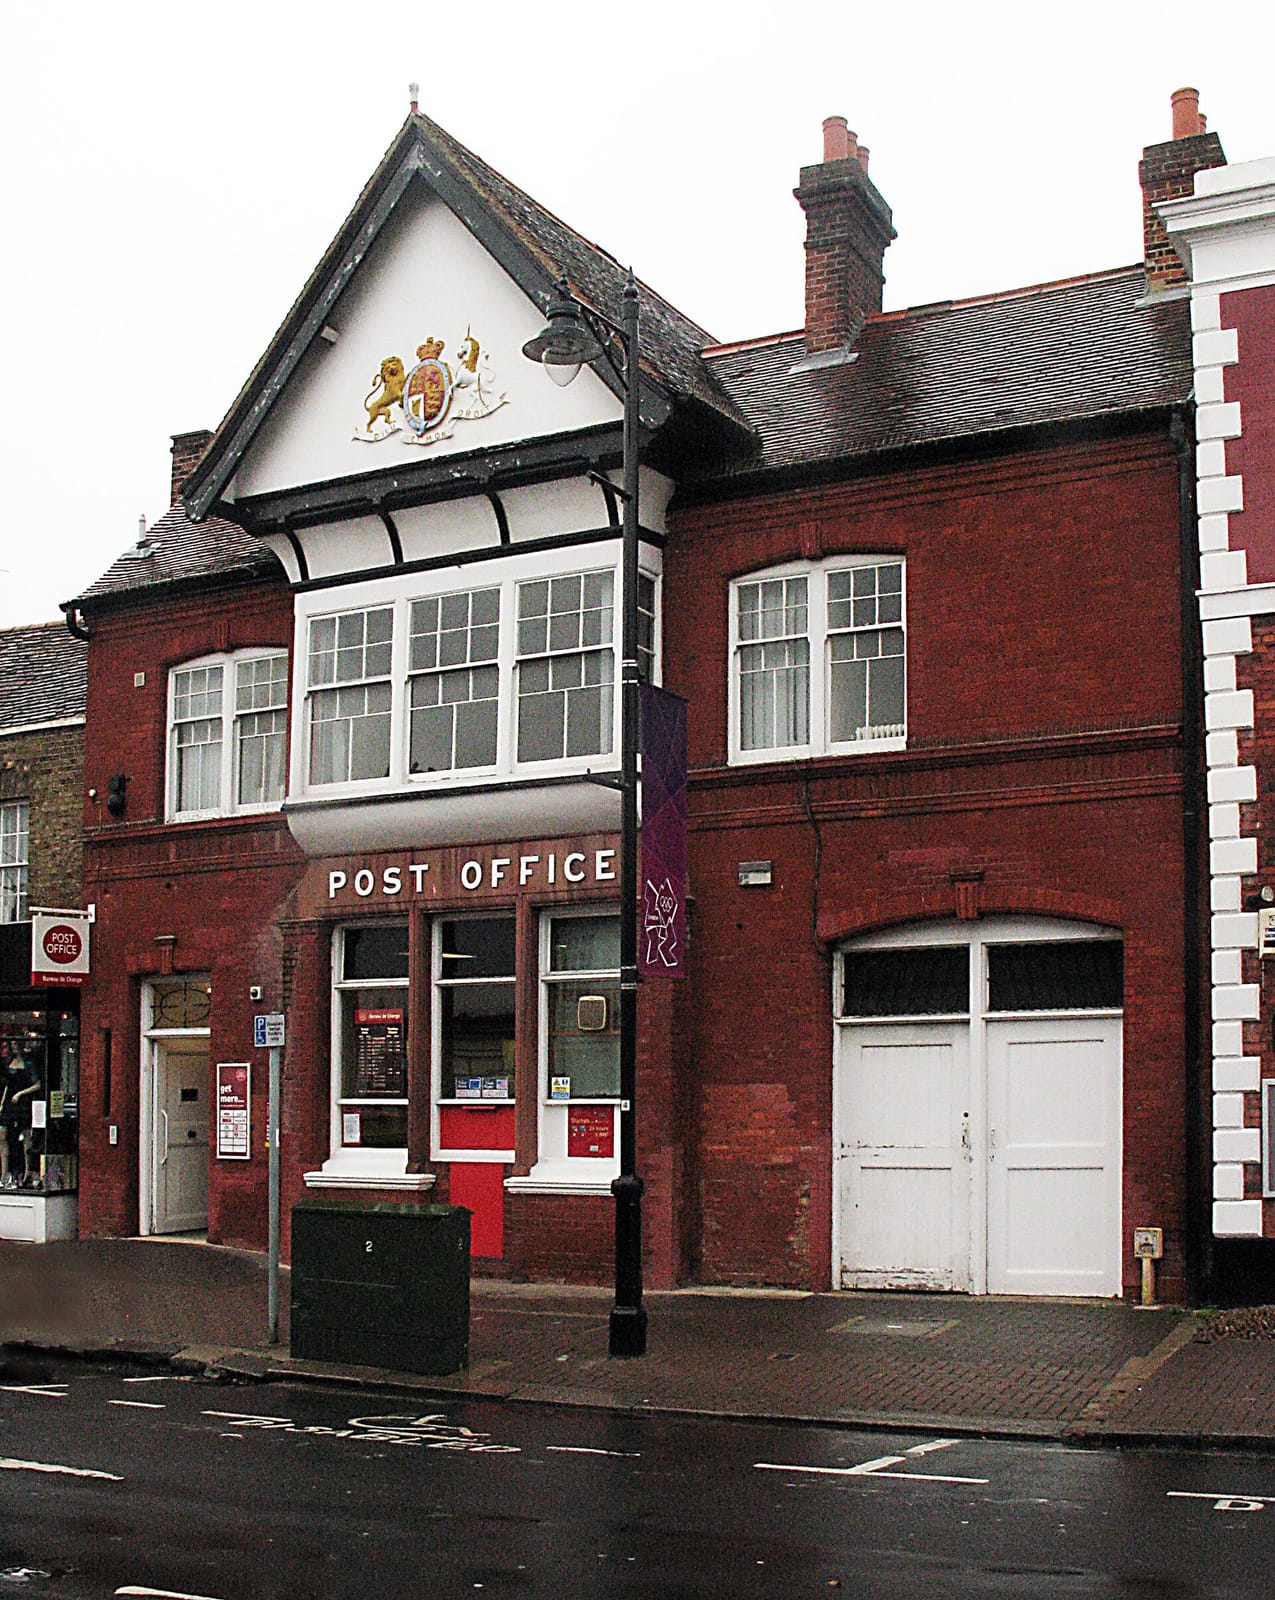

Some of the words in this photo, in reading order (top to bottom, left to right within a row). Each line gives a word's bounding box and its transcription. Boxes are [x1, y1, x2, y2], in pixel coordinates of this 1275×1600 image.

[329, 863, 429, 899] POST
[461, 849, 617, 890] OFFICE
[52, 932, 75, 944] POST
[46, 943, 78, 955] OFFICE
[257, 1018, 265, 1030] P
[220, 1084, 233, 1095] get
[365, 1240, 373, 1252] 2
[228, 1419, 522, 1452] DISABLED
